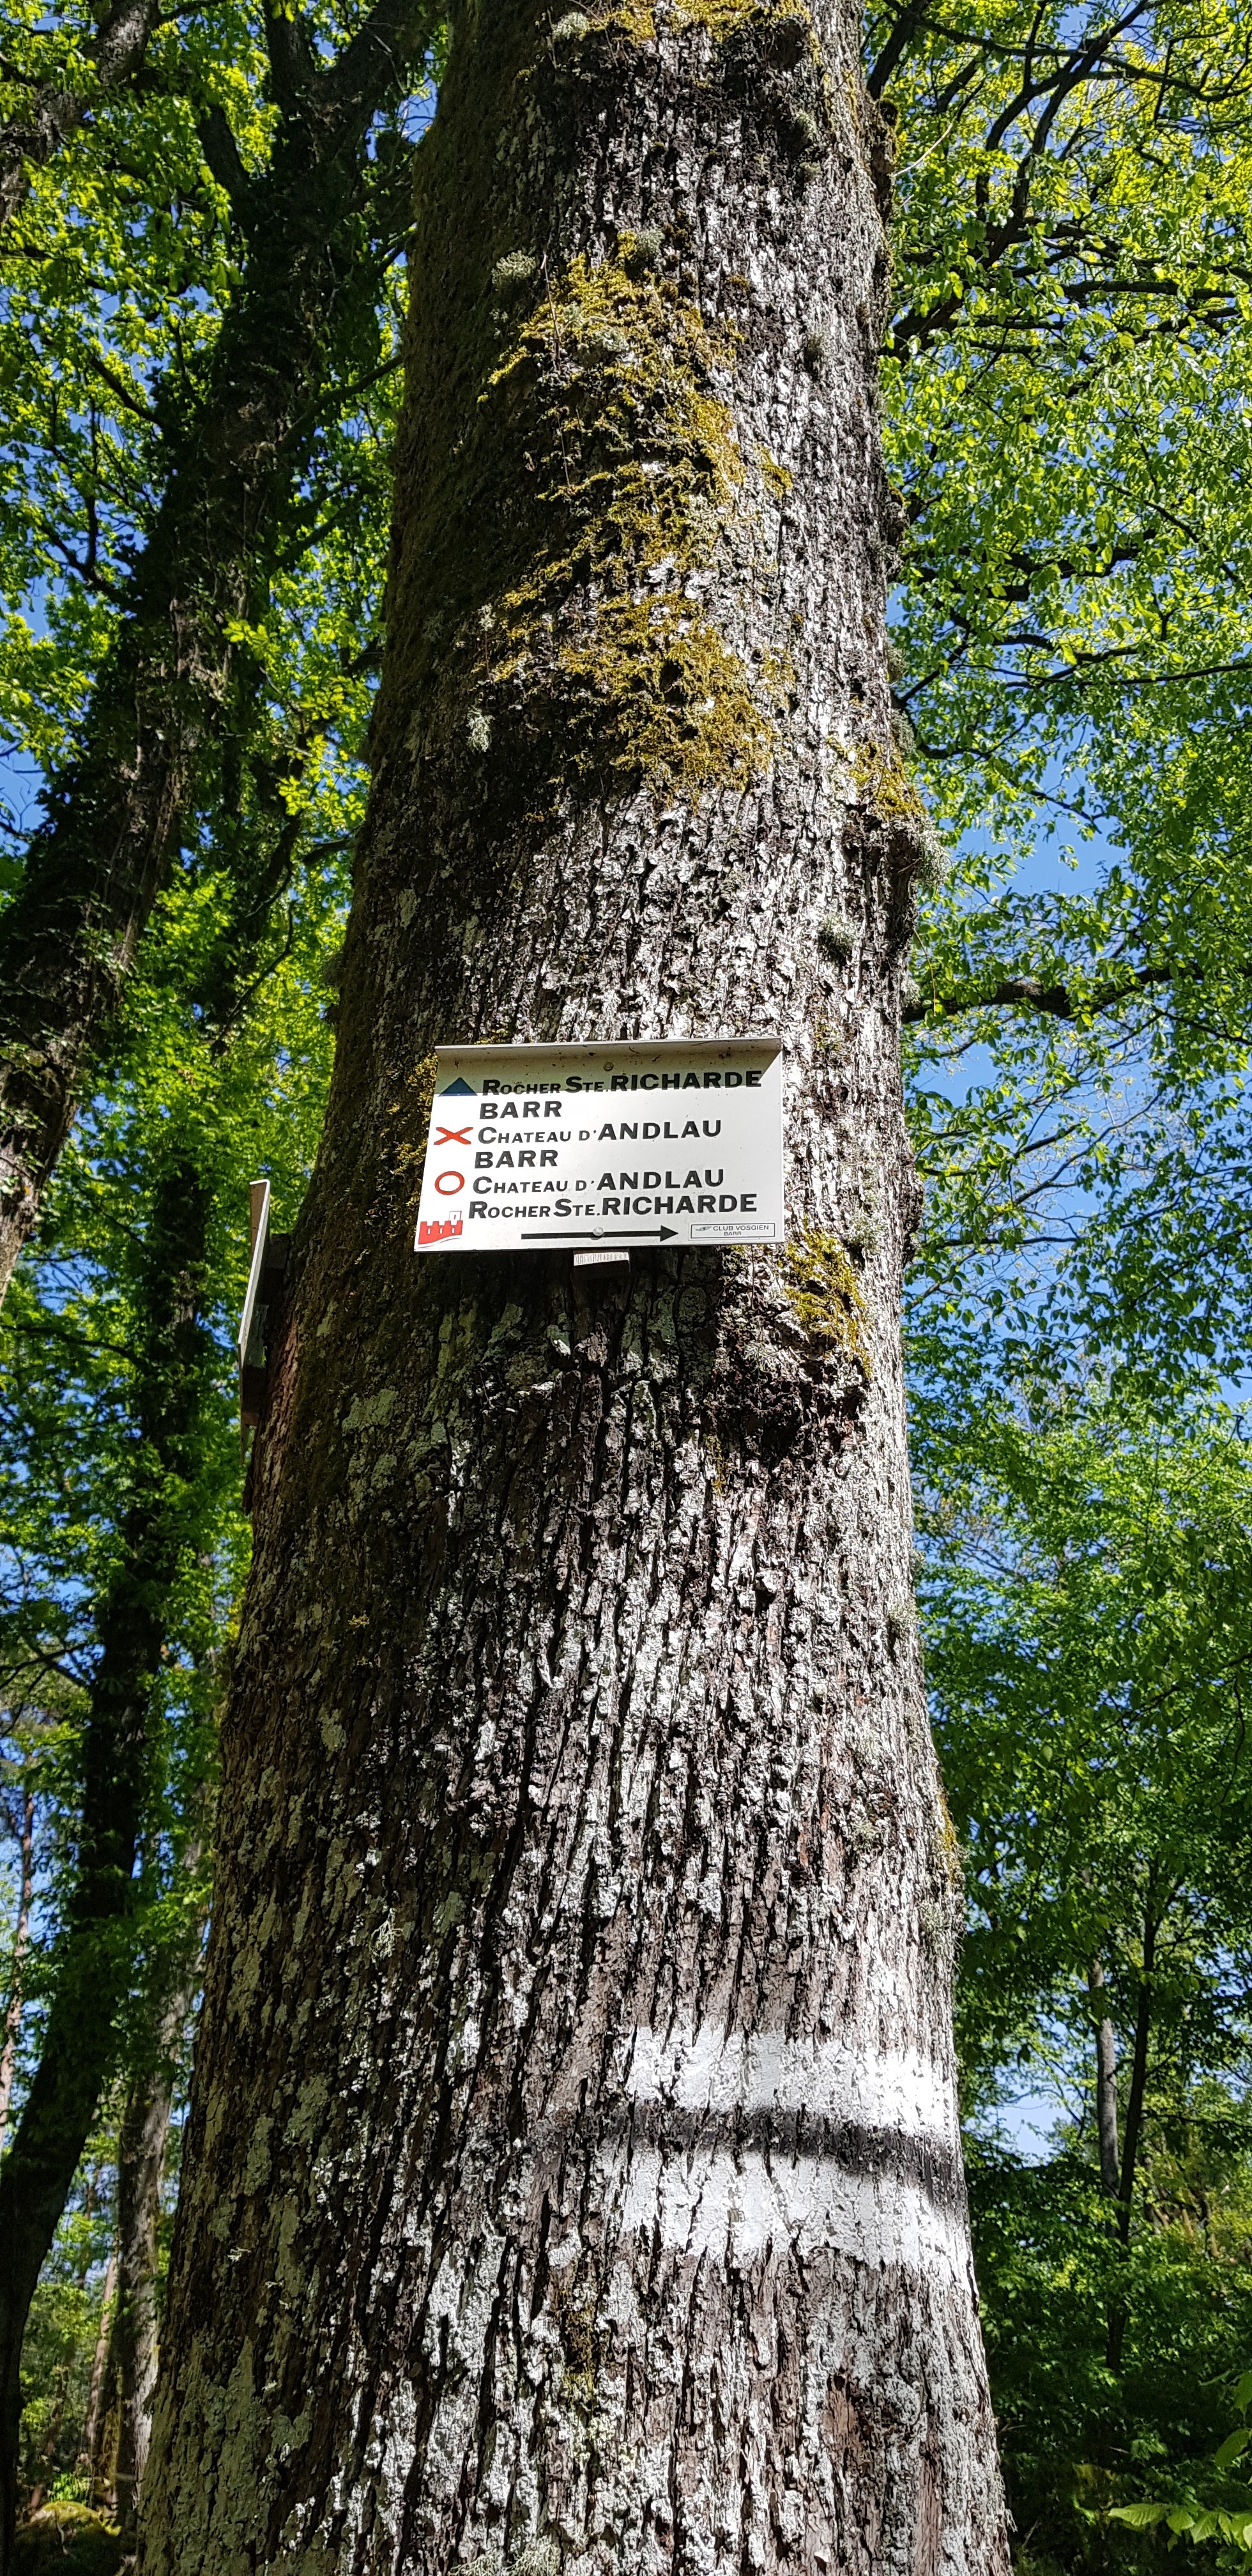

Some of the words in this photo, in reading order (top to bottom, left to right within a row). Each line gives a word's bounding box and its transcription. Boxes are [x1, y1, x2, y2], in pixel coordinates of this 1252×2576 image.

[611, 1071, 762, 1092] RICHARDE
[479, 1100, 563, 1120] BARR
[478, 1126, 572, 1144] CHATEAU
[474, 1150, 558, 1169] BARR
[473, 1176, 569, 1194] CHATEAU
[602, 1193, 758, 1214] RICHARDE
